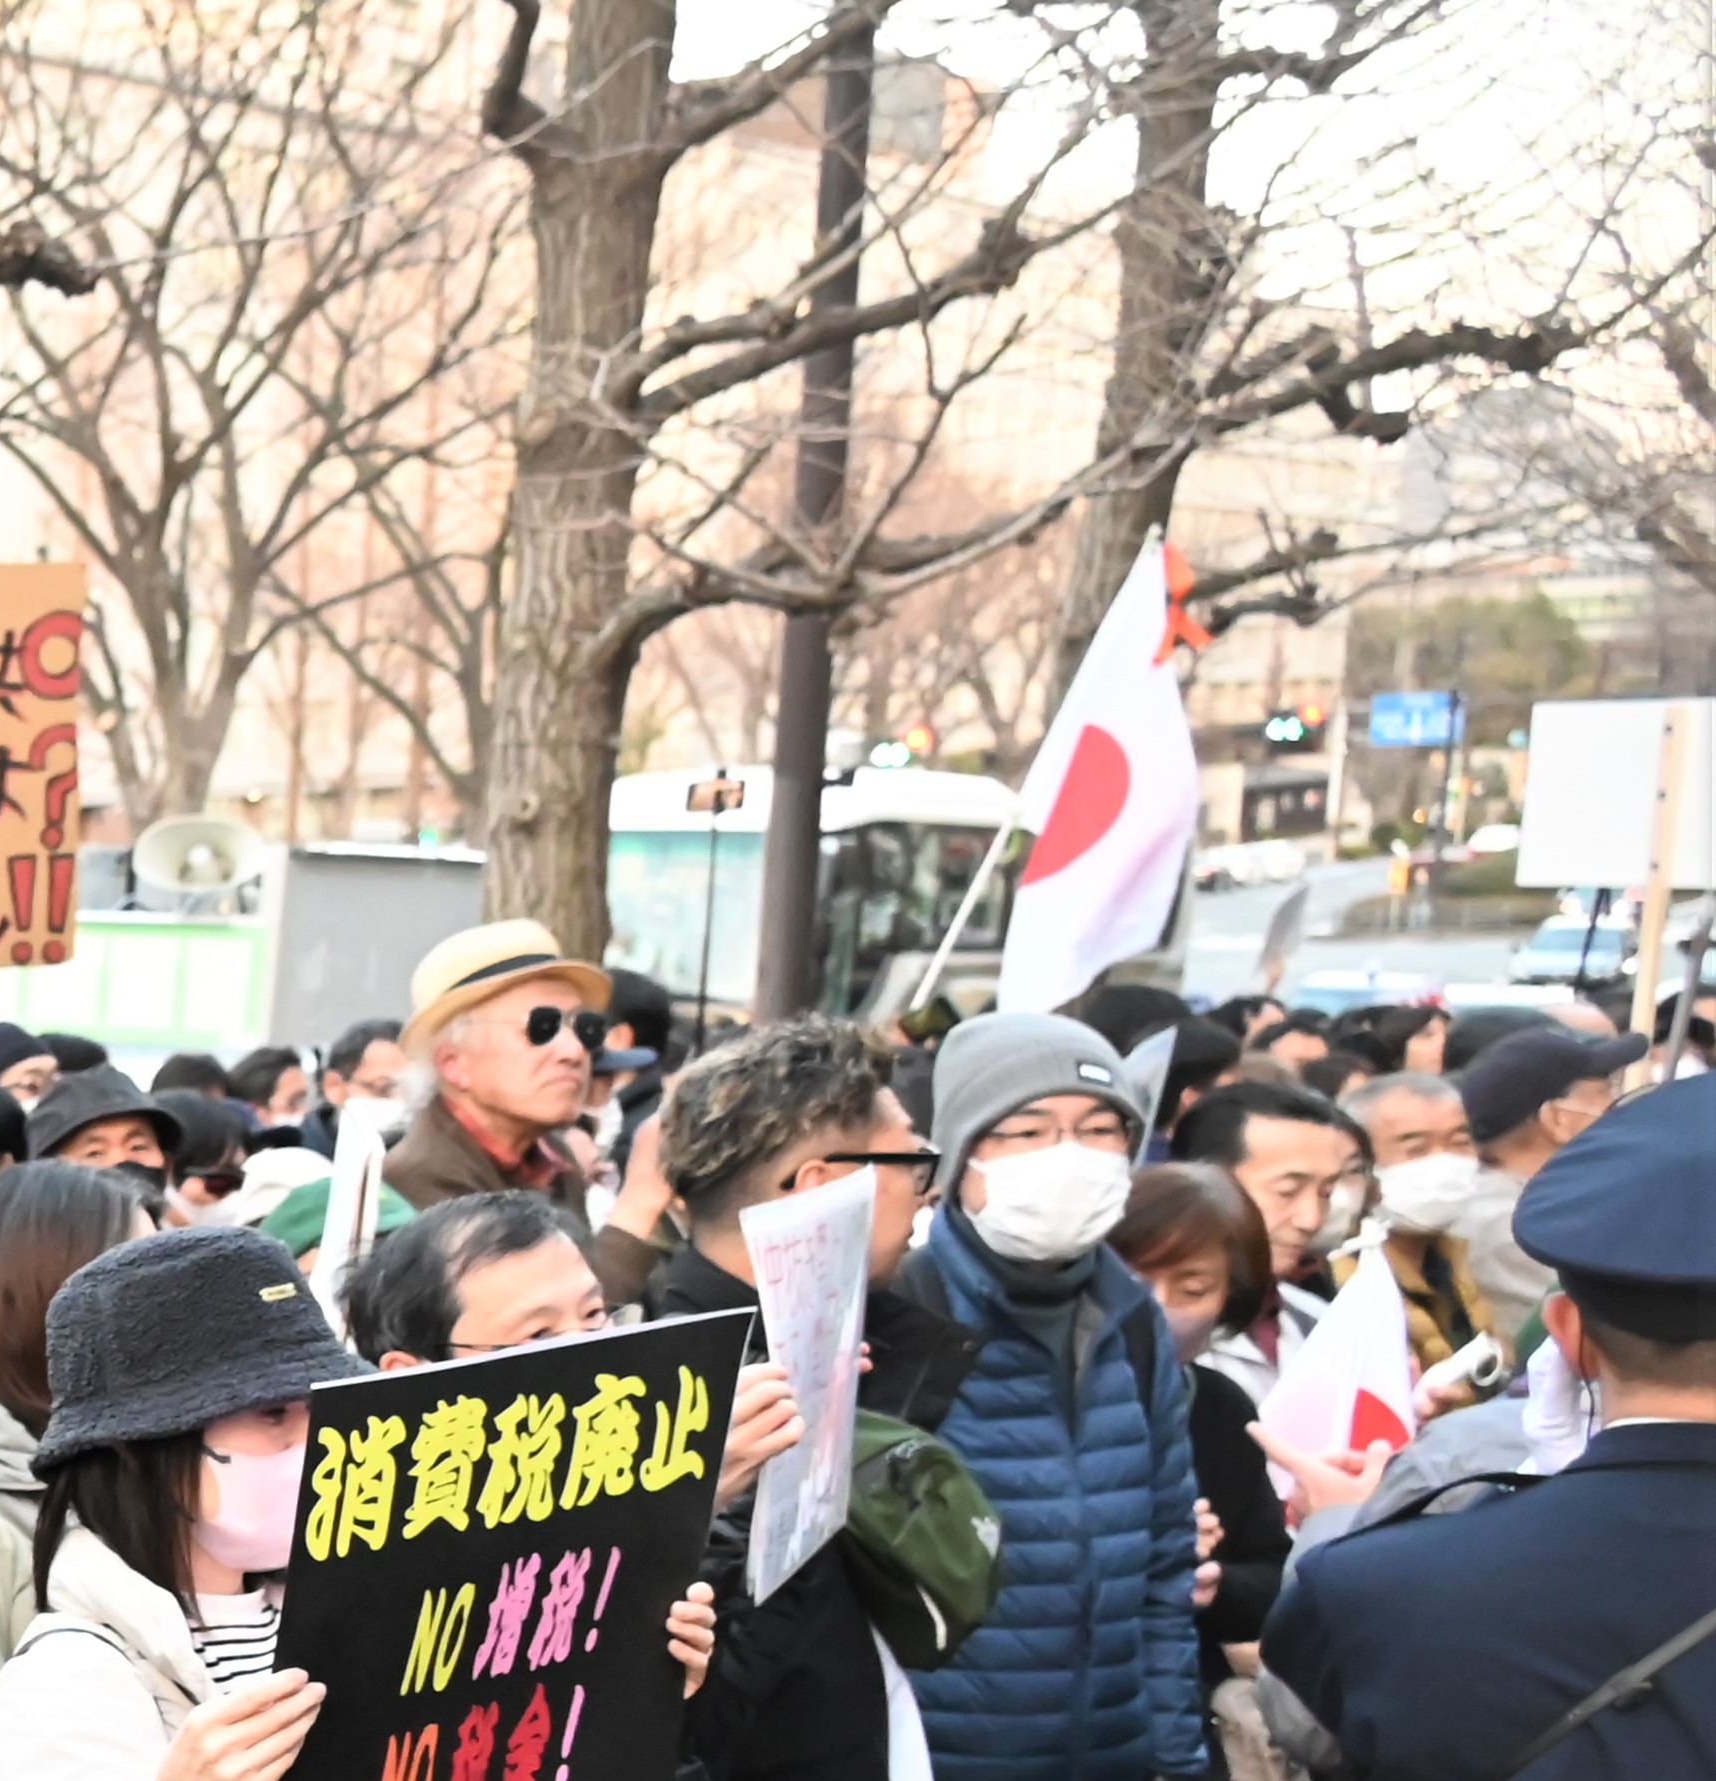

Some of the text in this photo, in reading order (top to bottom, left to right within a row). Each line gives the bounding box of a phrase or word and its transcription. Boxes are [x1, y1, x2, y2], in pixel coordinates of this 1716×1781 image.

[304, 1364, 711, 1562] 消費税廃止
[400, 1582, 477, 1696] NO
